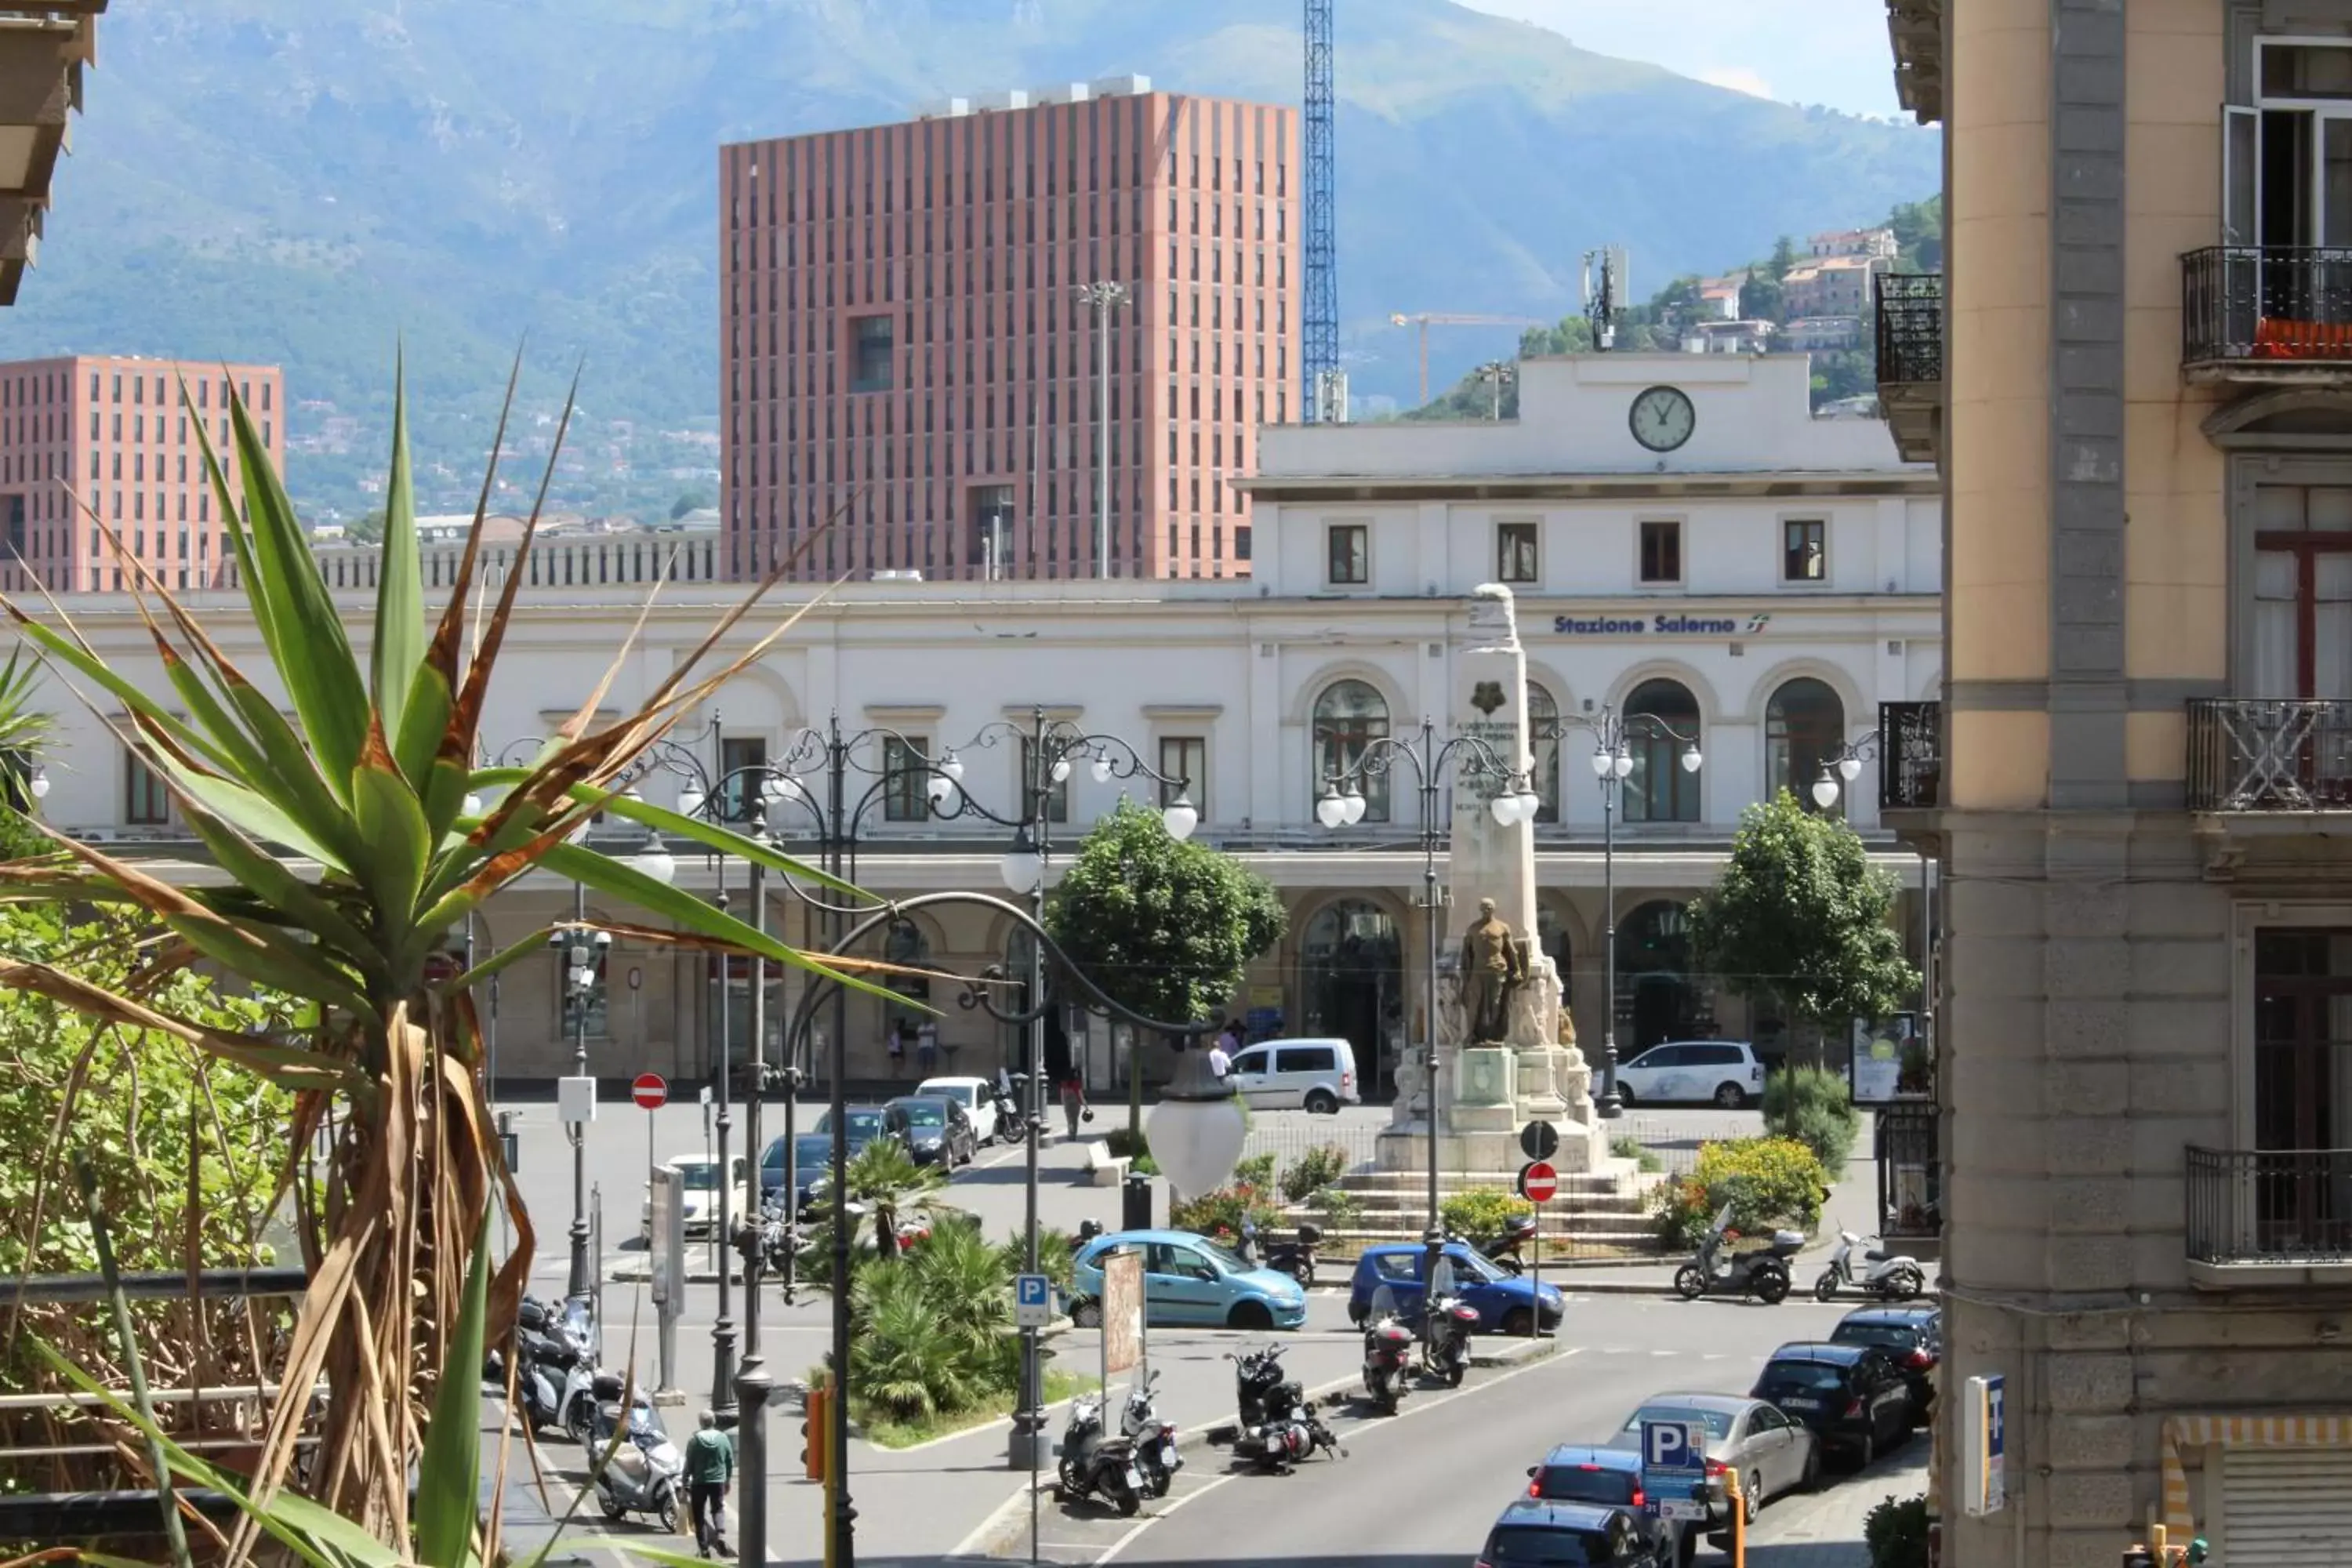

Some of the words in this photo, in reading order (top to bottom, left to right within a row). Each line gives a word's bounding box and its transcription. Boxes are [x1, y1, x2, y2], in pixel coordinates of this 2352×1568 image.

[1555, 615, 1645, 633] Stazione
[1655, 615, 1736, 633] Salerno
[1025, 1280, 1040, 1301] P
[1652, 1425, 1682, 1464] P
